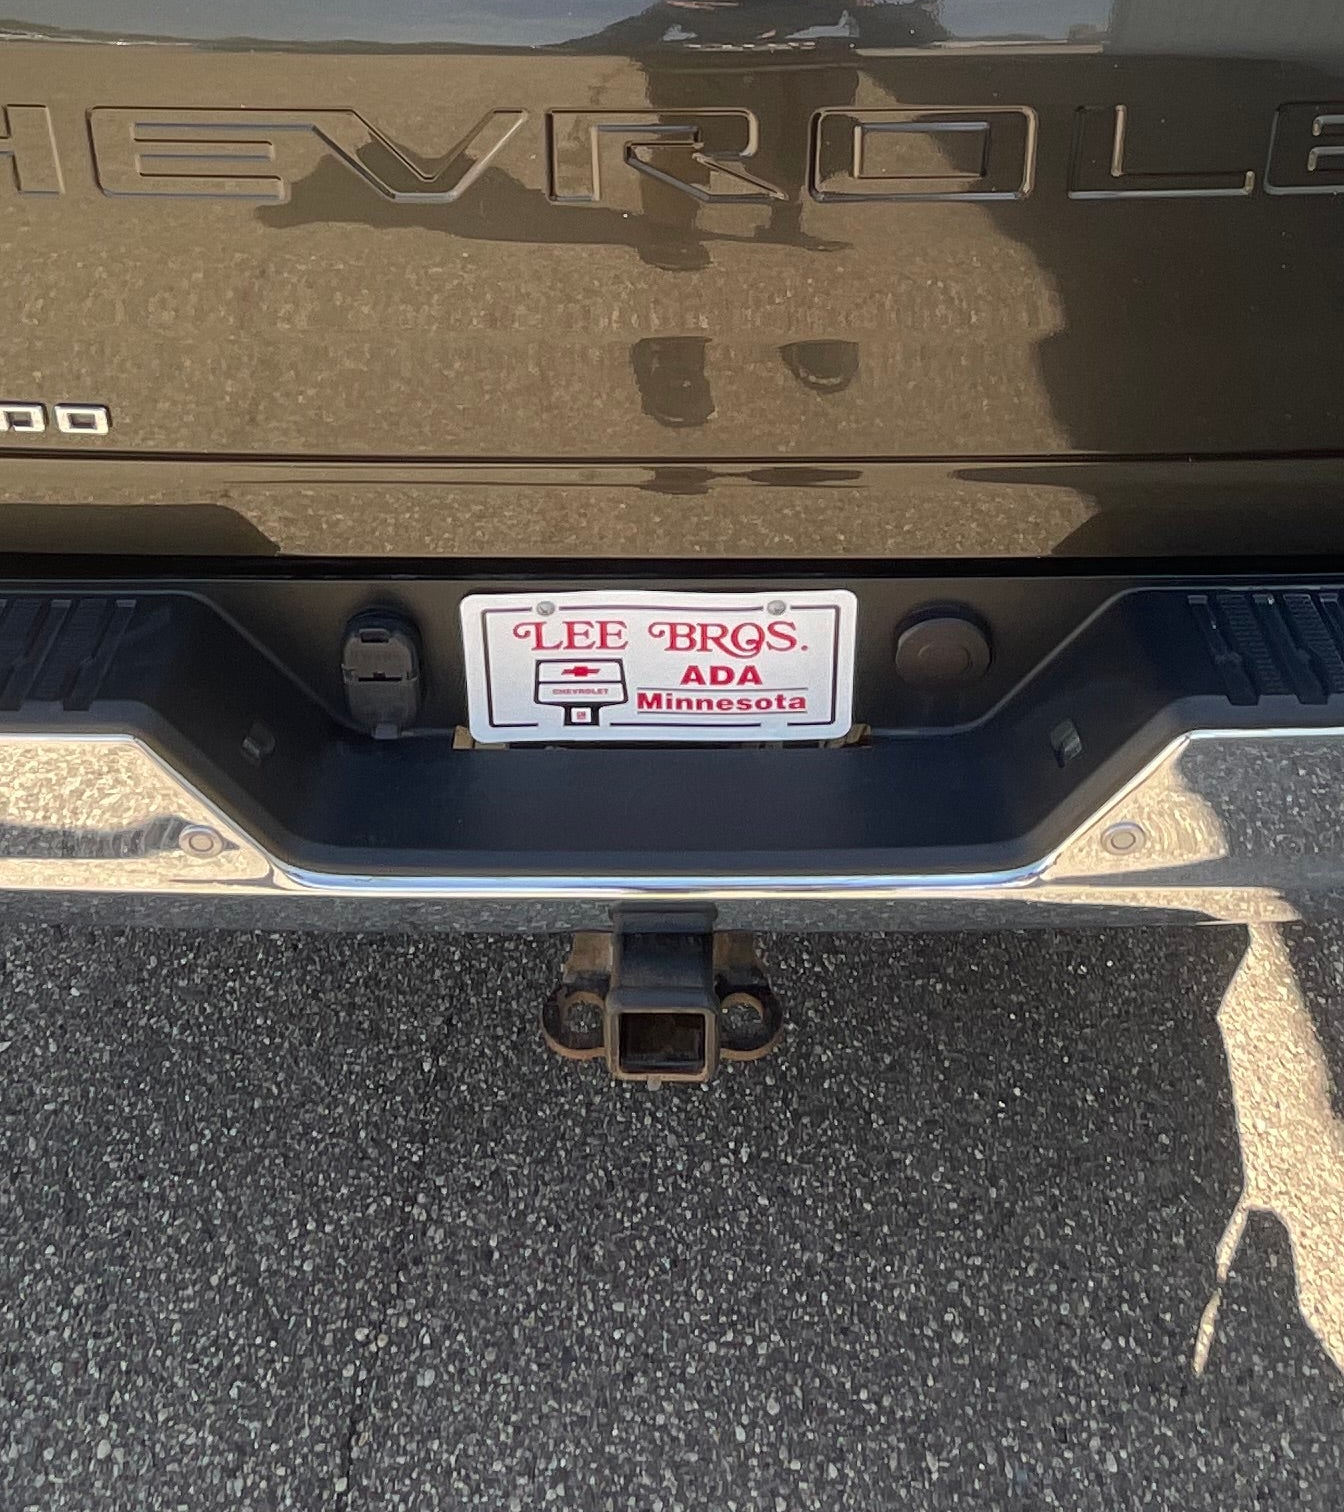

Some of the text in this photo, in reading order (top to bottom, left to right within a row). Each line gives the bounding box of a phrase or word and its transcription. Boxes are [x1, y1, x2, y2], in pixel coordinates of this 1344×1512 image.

[512, 620, 809, 659] LEE BROS.
[679, 665, 763, 686] ADA
[636, 691, 807, 711] Minnesota
